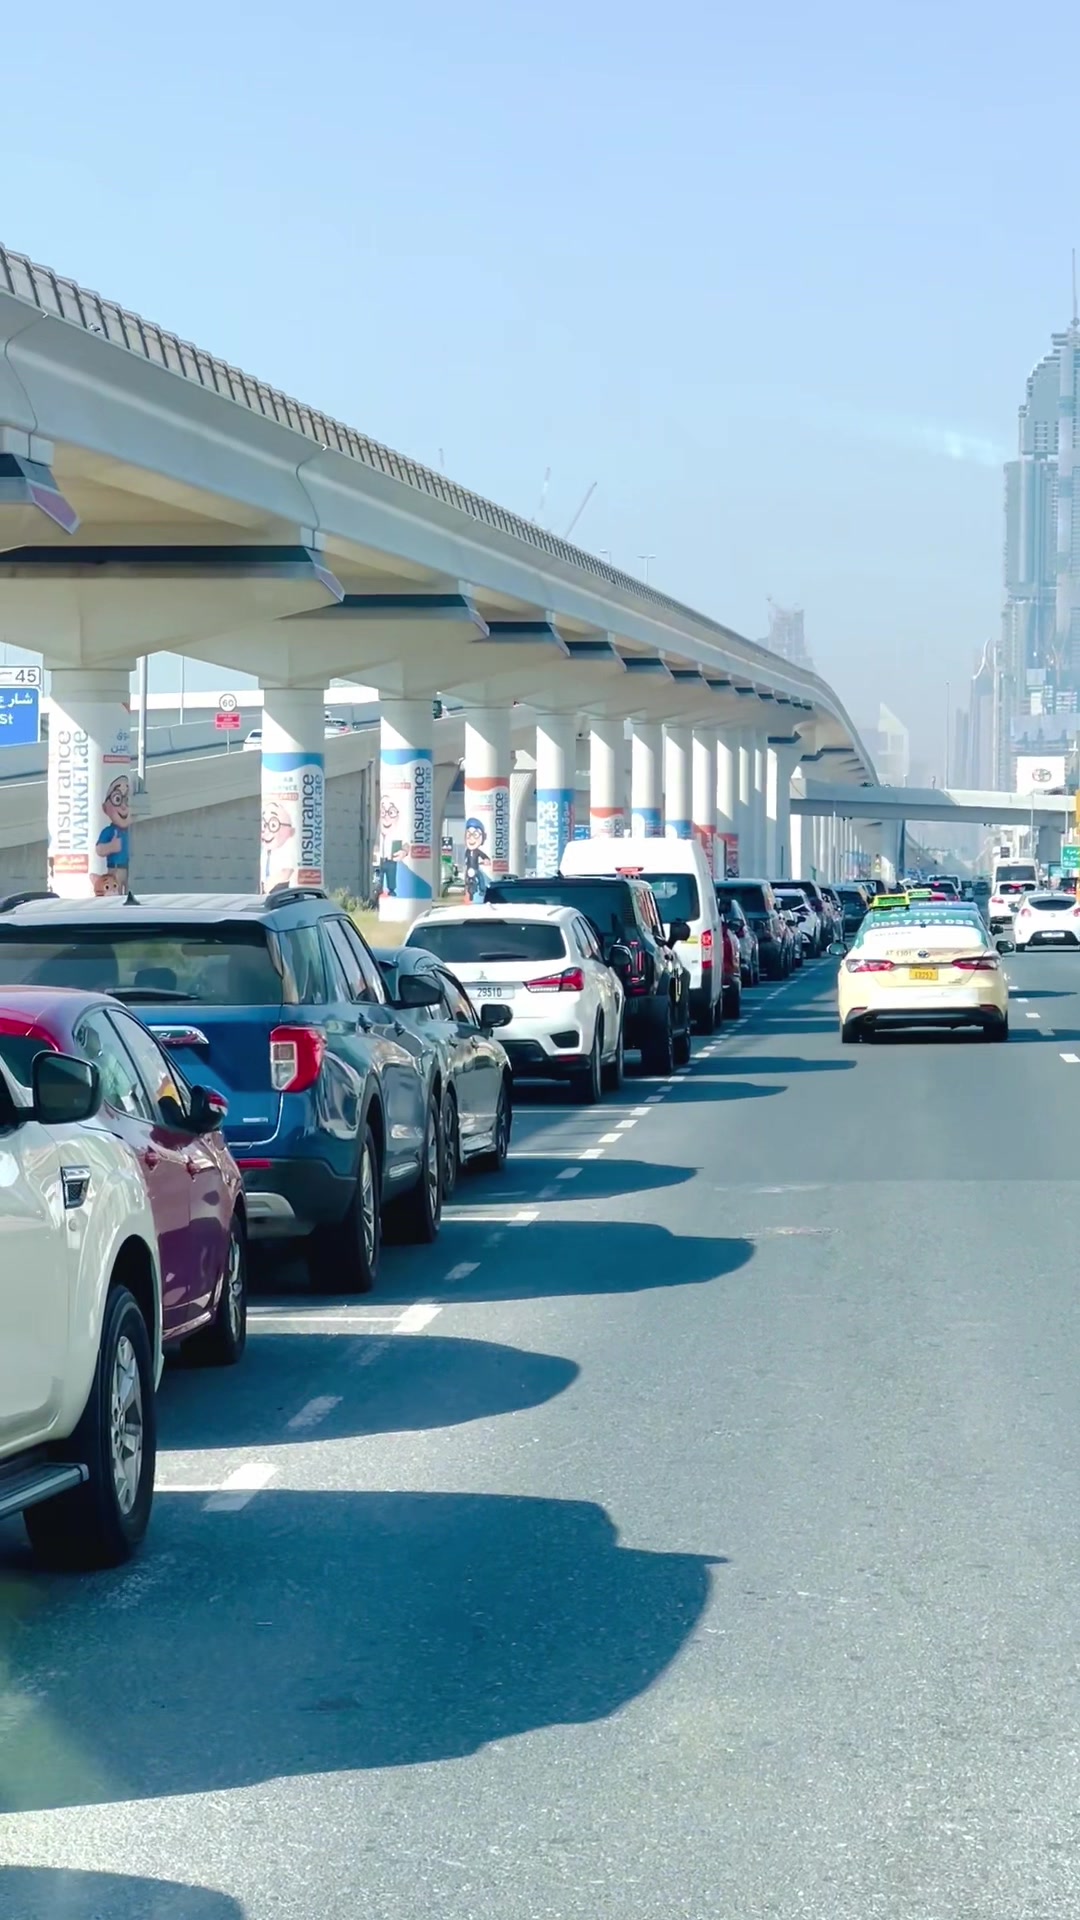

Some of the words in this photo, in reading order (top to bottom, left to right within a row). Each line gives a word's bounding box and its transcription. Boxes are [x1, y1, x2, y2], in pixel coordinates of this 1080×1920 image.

[15, 669, 37, 683] 45
[222, 699, 235, 708] 60
[58, 730, 71, 850] insurance
[72, 729, 89, 851] MARKET.ae
[298, 773, 314, 867] insurance
[411, 766, 425, 844] insurance
[492, 792, 504, 859] insurance
